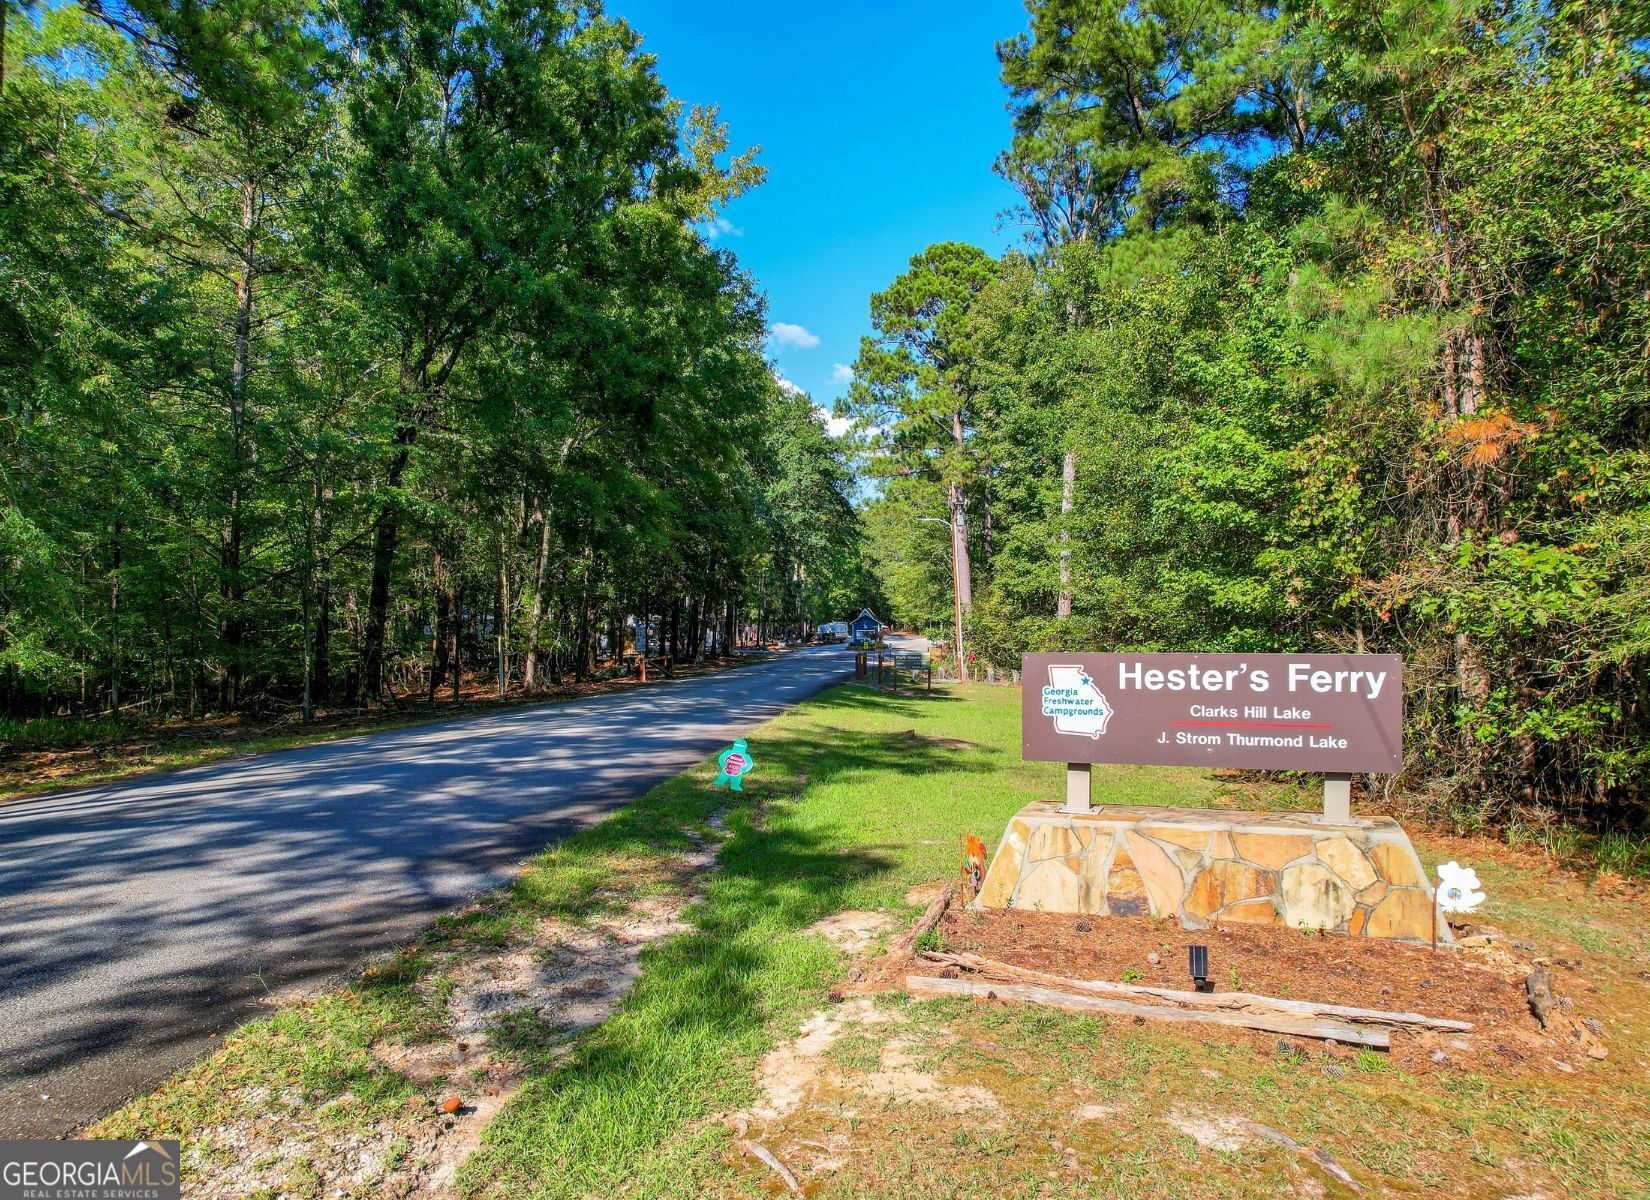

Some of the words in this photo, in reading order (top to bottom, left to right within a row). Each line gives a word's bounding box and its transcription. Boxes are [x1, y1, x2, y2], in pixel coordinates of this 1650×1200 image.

[1118, 662, 1269, 692] Hester's
[1288, 664, 1386, 700] Ferry
[1044, 687, 1078, 697] Georgia
[1044, 697, 1094, 706] Freshwater
[1043, 706, 1104, 716] Campgrounds
[1190, 704, 1238, 719] Clarks
[1244, 706, 1267, 719] Hill
[1274, 707, 1311, 720] Lake
[1157, 731, 1169, 744] J.
[1176, 732, 1221, 745] Strom
[1226, 733, 1303, 748] Thurmond
[1309, 735, 1348, 749] Lake
